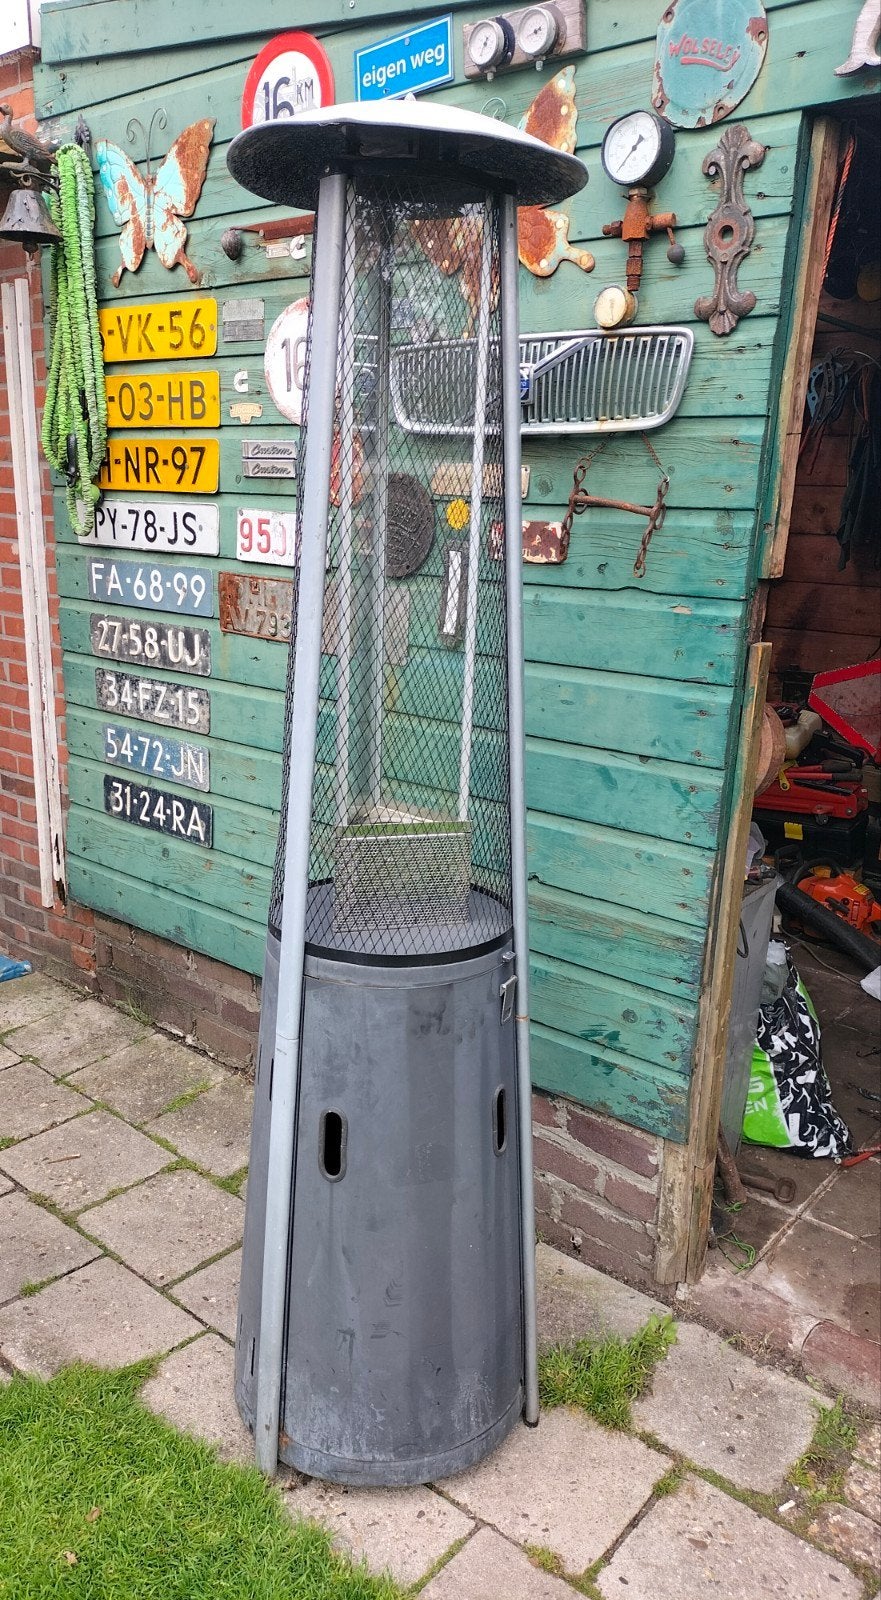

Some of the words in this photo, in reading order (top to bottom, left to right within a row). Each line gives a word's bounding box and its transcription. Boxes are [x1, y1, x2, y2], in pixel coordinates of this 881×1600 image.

[362, 58, 407, 88] eigen
[410, 42, 446, 69] weg
[262, 76, 294, 121] 16
[297, 78, 314, 104] KM
[100, 307, 206, 354] -VK-56
[252, 443, 293, 456] Custom
[252, 462, 292, 475] Custom
[94, 507, 197, 546] PY-78-JS
[91, 562, 206, 608] FA-68-99
[97, 619, 201, 667] 27-58-UJ
[105, 675, 200, 725] 34-FZ-15
[106, 728, 204, 784] 54-72-JN
[112, 781, 205, 841] 31-24-RA
